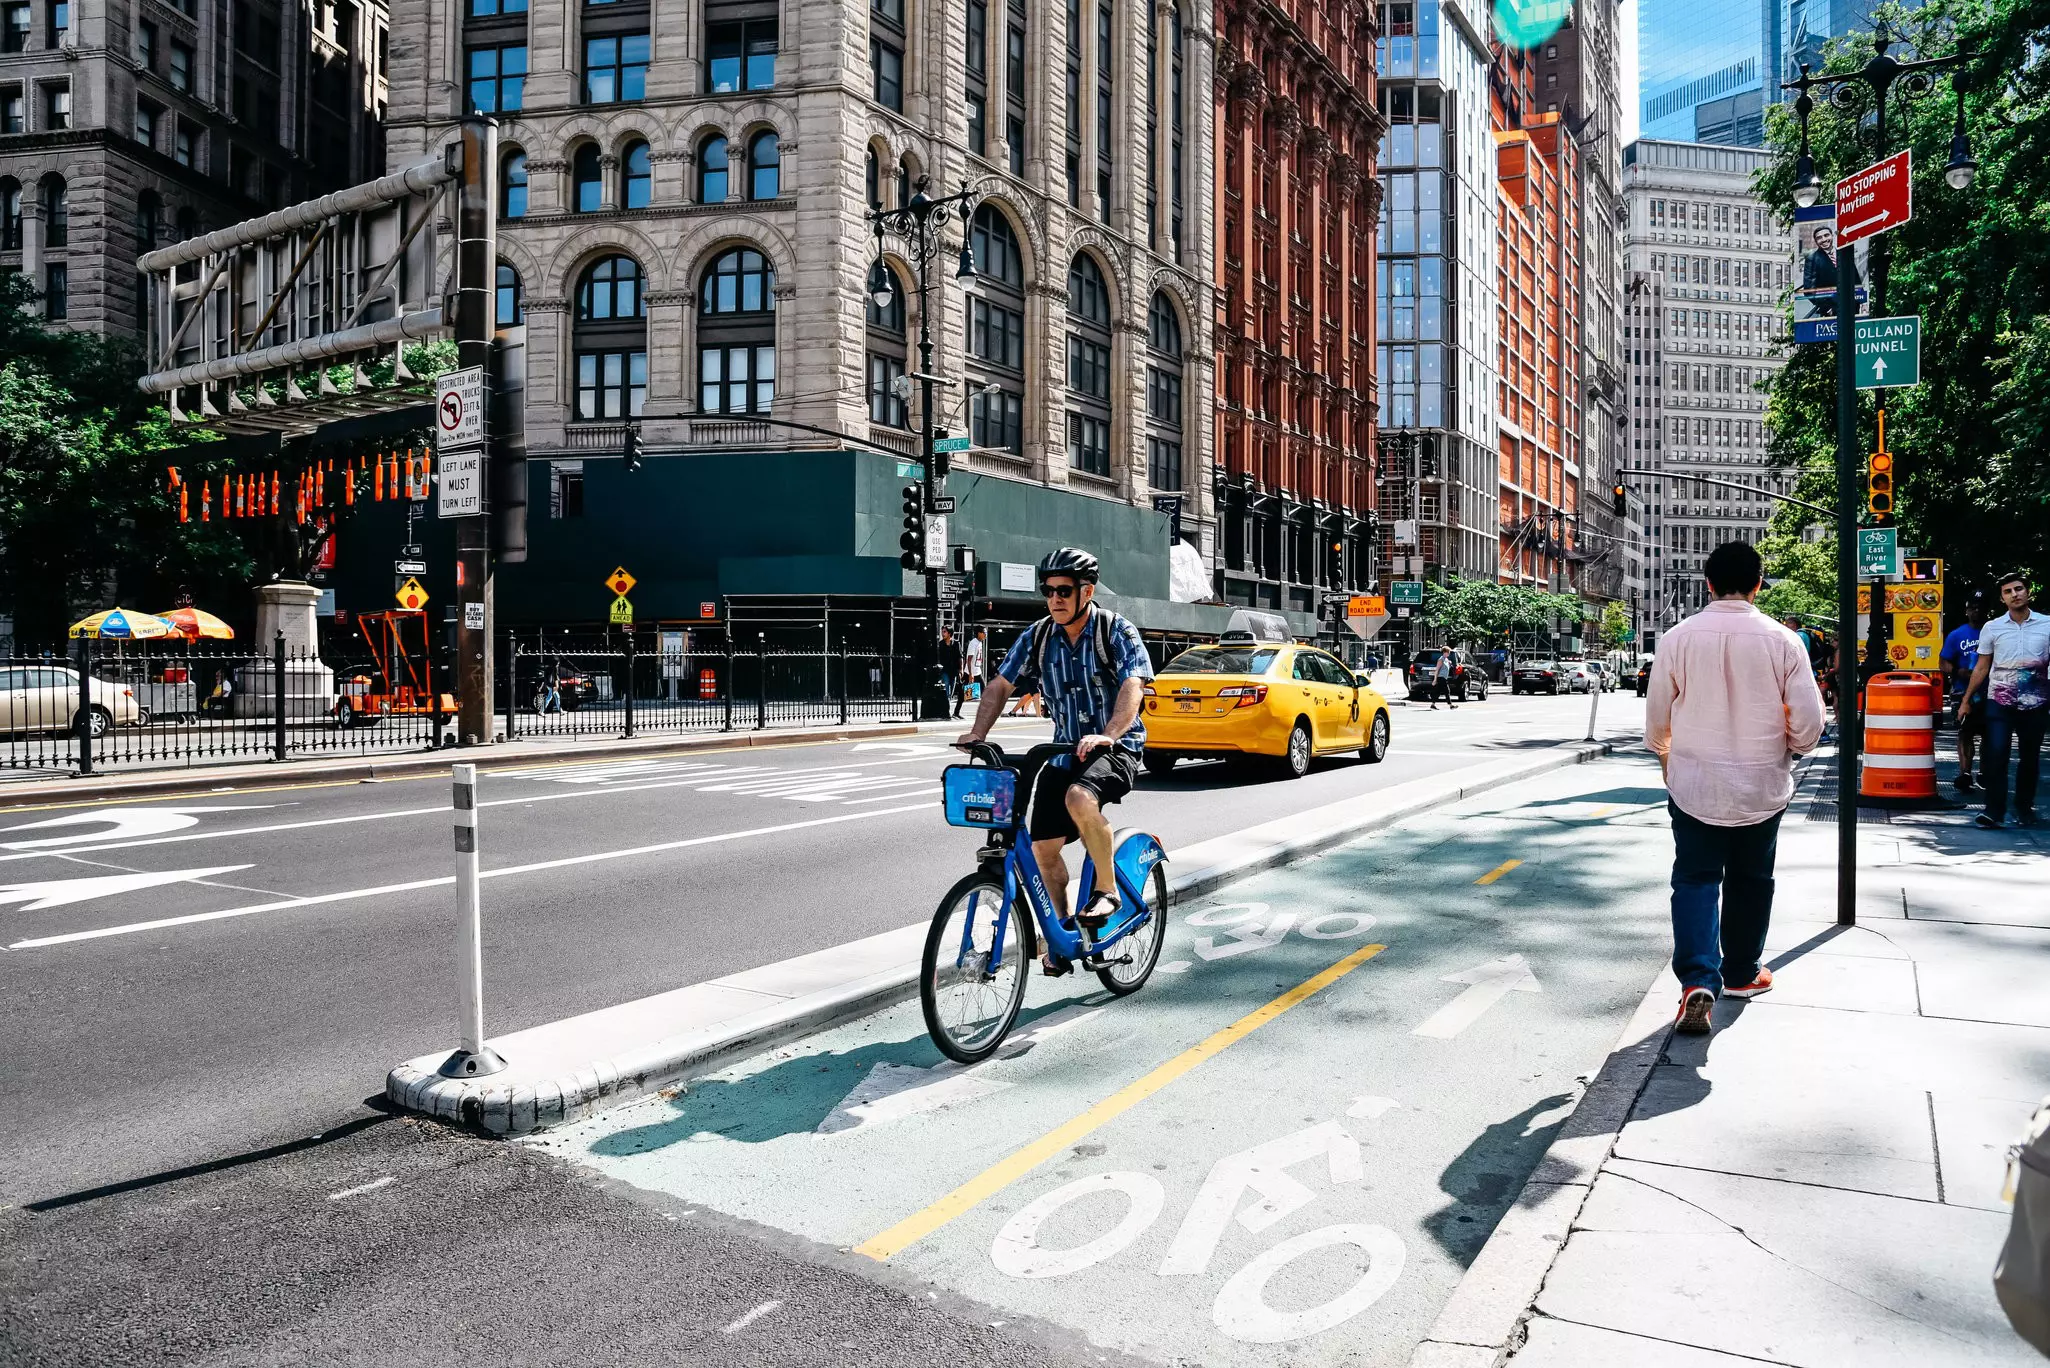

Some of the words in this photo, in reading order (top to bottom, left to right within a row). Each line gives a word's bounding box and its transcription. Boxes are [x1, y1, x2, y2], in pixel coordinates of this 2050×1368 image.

[1840, 184, 1852, 200] NO
[1853, 164, 1896, 194] STOPPING
[1840, 192, 1875, 216] Anytime
[1816, 322, 1837, 333] PAC
[1855, 324, 1913, 339] OLLAND
[1855, 340, 1908, 355] TUNNEL
[439, 376, 465, 390] RESTRICTED
[468, 372, 480, 384] AREA
[462, 386, 480, 399] TRUCKS
[463, 404, 469, 413] 33
[470, 402, 475, 412] FT
[476, 401, 480, 410] &
[466, 415, 478, 426] OVER
[934, 439, 962, 452] SPRUCE
[442, 462, 457, 472] LEFT
[460, 460, 477, 470] LANE
[448, 478, 470, 491] MUST
[442, 498, 458, 509] TURN
[462, 496, 477, 507] LEFT
[932, 546, 941, 554] PED
[930, 554, 945, 562] SIGNAL
[1866, 554, 1886, 562] River
[612, 614, 630, 622] AHEAD
